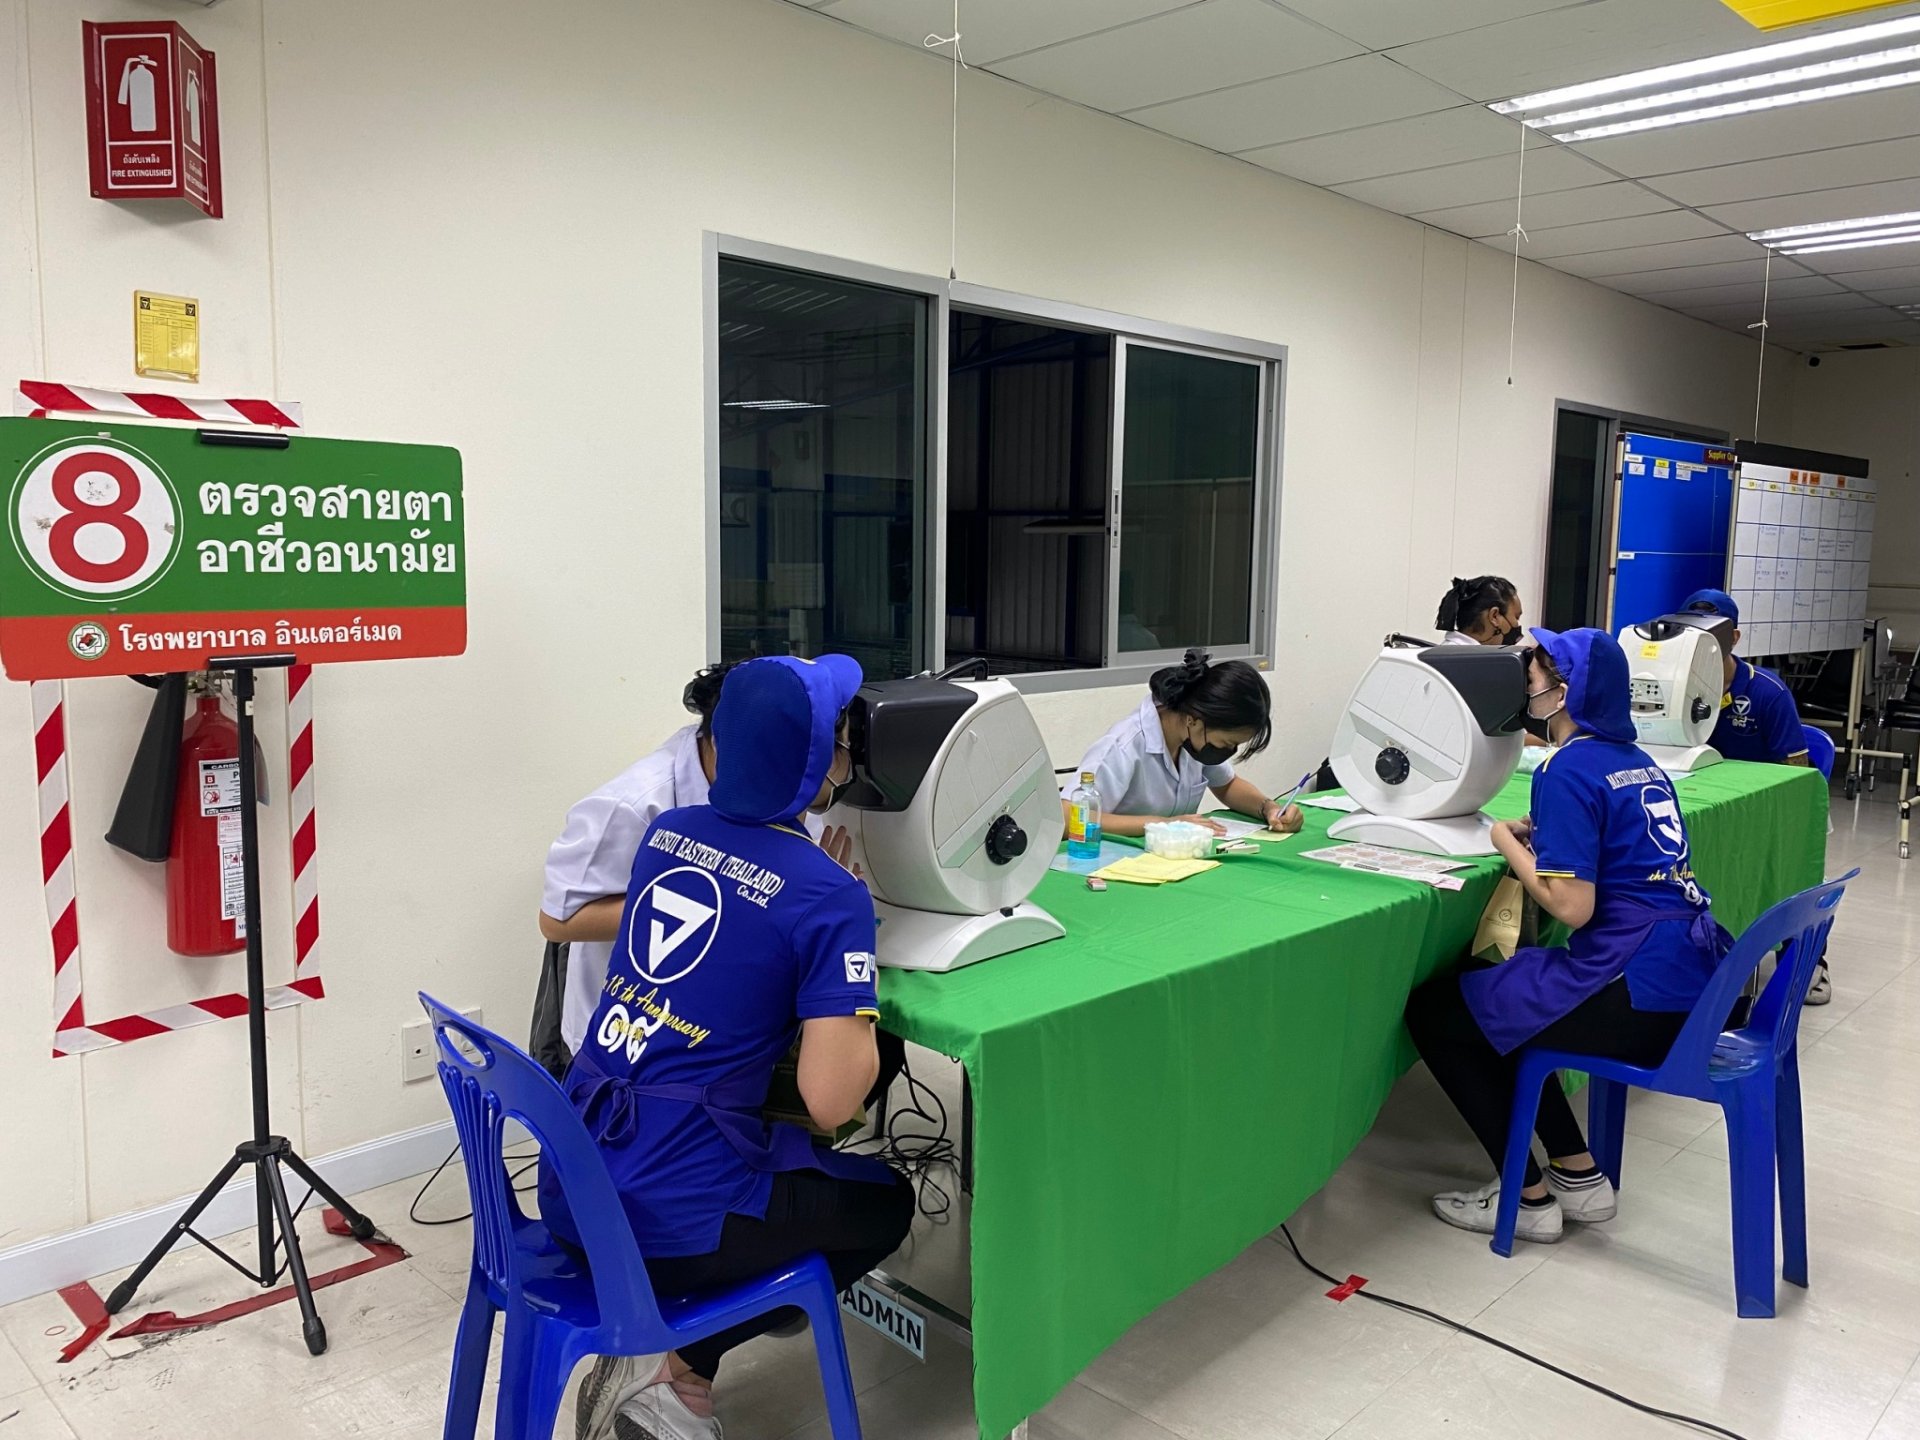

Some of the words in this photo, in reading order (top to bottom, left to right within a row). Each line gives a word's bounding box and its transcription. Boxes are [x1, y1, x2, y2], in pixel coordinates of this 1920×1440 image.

[123, 153, 160, 163] ถังดับเพลิง
[128, 169, 172, 177] EXTINGUISHER
[49, 452, 149, 583] 8
[199, 481, 452, 521] ตรวจสายตา
[197, 522, 456, 572] อาชีวอนามัย
[118, 623, 267, 652] โรงพยาบาล
[275, 616, 402, 646] อินเตอร์เมด
[675, 837, 728, 872] EASTERN
[719, 855, 786, 899] (THAILAND)
[842, 1286, 921, 1352] ADMIN
